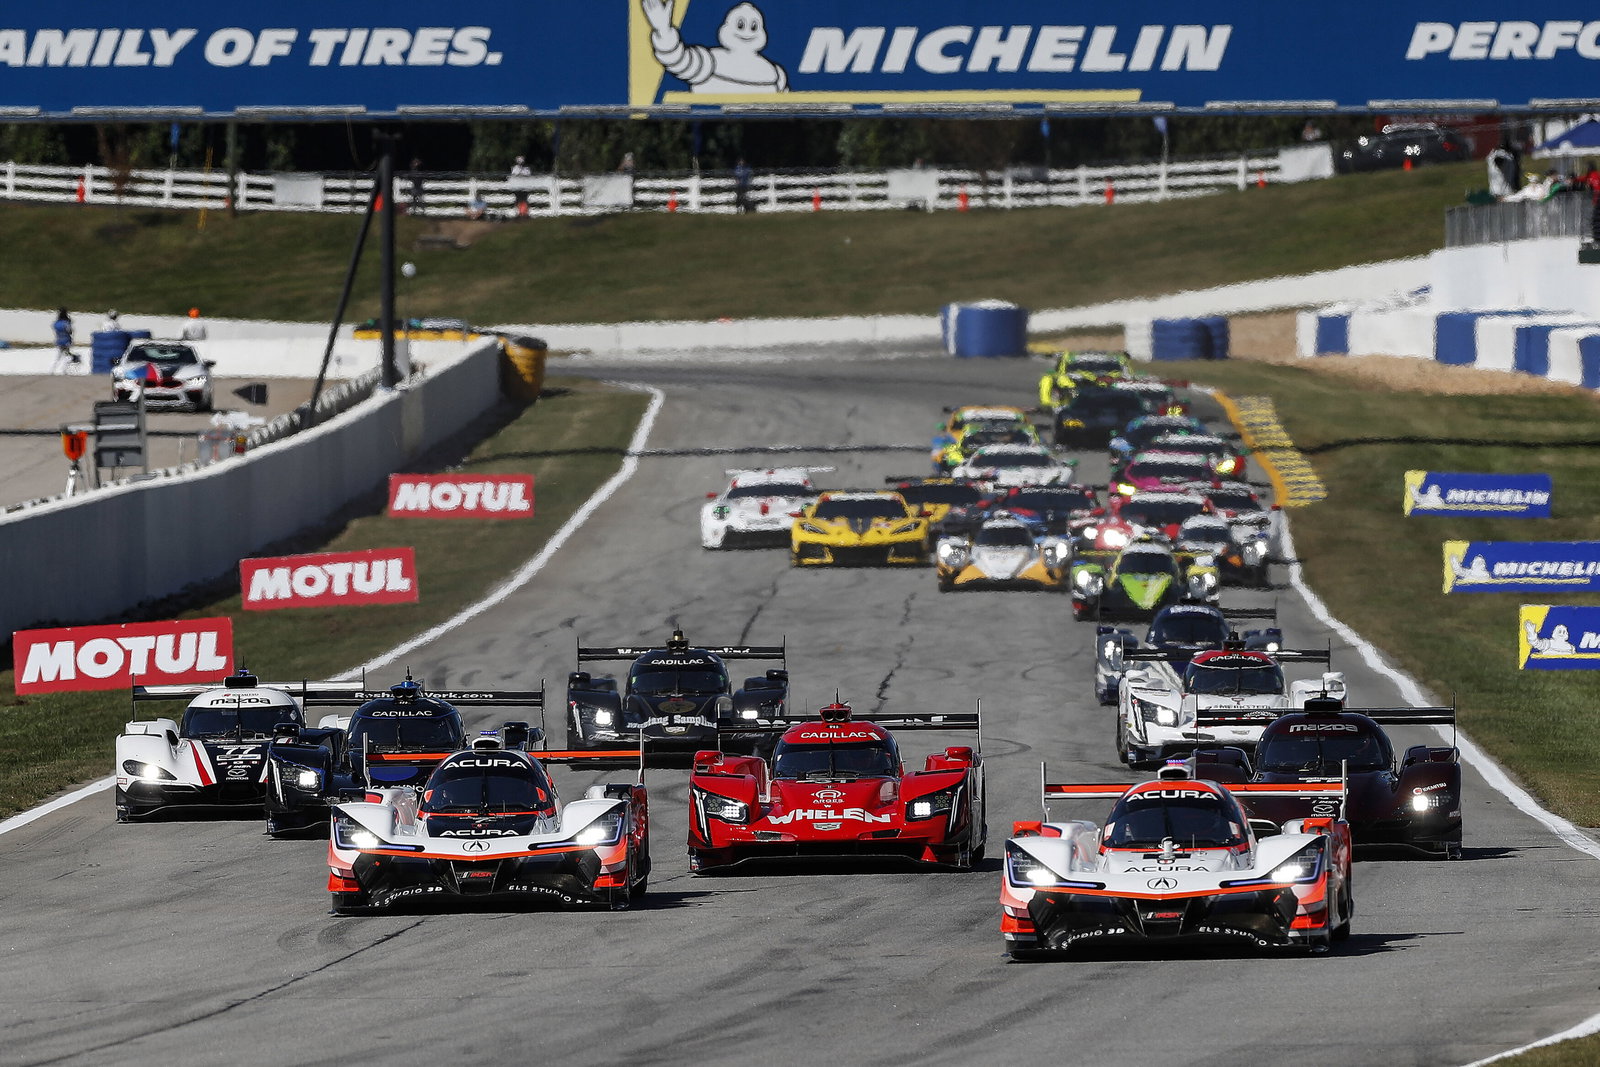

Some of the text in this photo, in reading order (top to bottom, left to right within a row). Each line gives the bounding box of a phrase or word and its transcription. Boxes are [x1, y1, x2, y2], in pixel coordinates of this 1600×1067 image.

[204, 27, 298, 67] OF
[308, 26, 503, 67] TIRES.
[798, 25, 1232, 74] MICHELIN
[392, 481, 532, 511] MOTUL
[1446, 488, 1551, 505] MICHELIN
[1492, 561, 1600, 576] MICHELI
[248, 558, 412, 602] MOTUL
[21, 630, 228, 684] MOTUL
[1209, 655, 1263, 663] CADILLAC
[800, 731, 867, 739] CADILLAC
[443, 759, 528, 770] ACURA
[1126, 790, 1219, 803] ACURA
[766, 807, 892, 825] WHELEN
[439, 828, 520, 837] ACURA
[1123, 865, 1210, 873] ACURA
[531, 885, 572, 902] STUDIO
[1107, 927, 1125, 935] 3D
